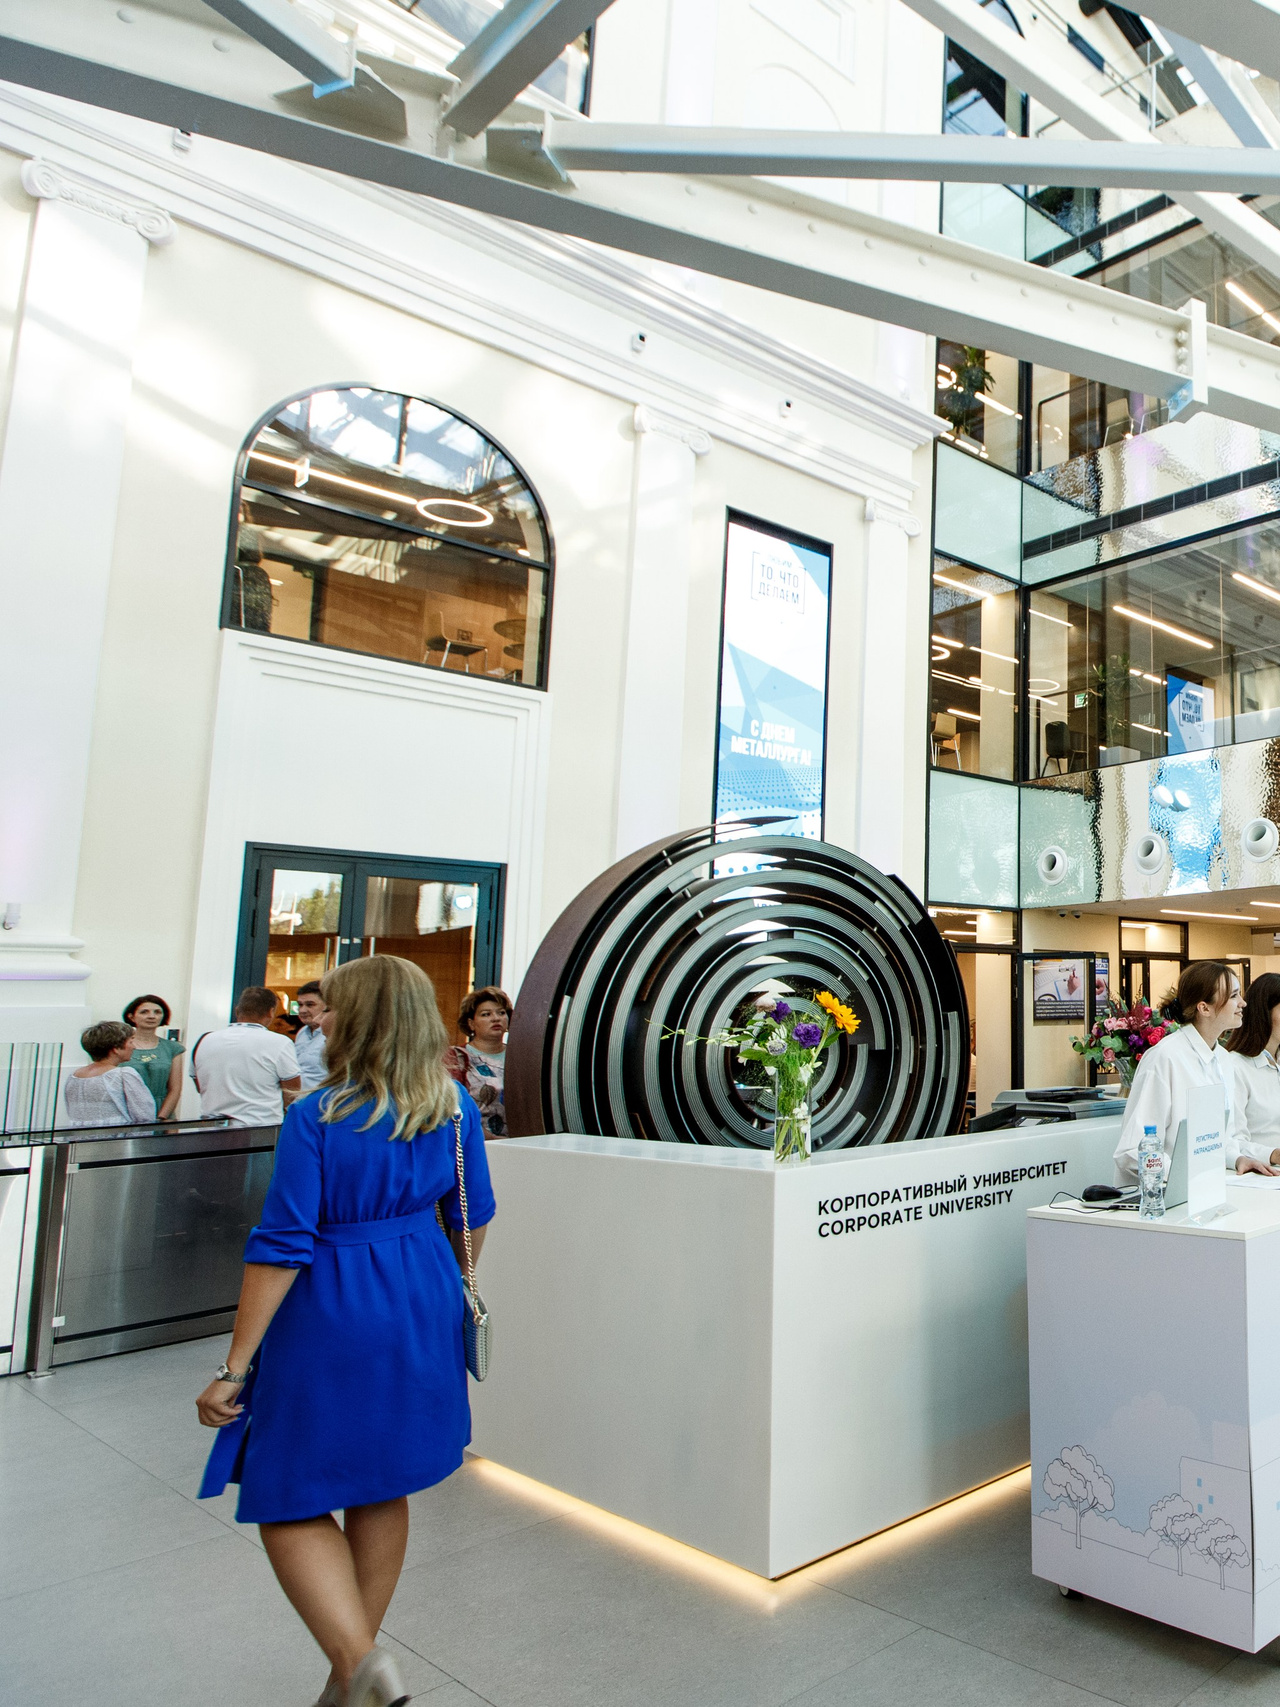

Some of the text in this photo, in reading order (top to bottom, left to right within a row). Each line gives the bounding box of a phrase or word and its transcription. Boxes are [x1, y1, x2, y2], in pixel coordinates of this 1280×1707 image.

[779, 570, 799, 588] ЧТО
[758, 582, 799, 604] ДЕЛАЕМ
[750, 719, 796, 744] С ДНЕМ
[1195, 1131, 1220, 1144] РЕГИСТРАЦИЯ
[818, 1160, 1067, 1215] КОРПОРАТИВНЫЙ УНИВЕРСИТЕТ
[818, 1189, 1013, 1238] CORPORATE UNIVERSITY
